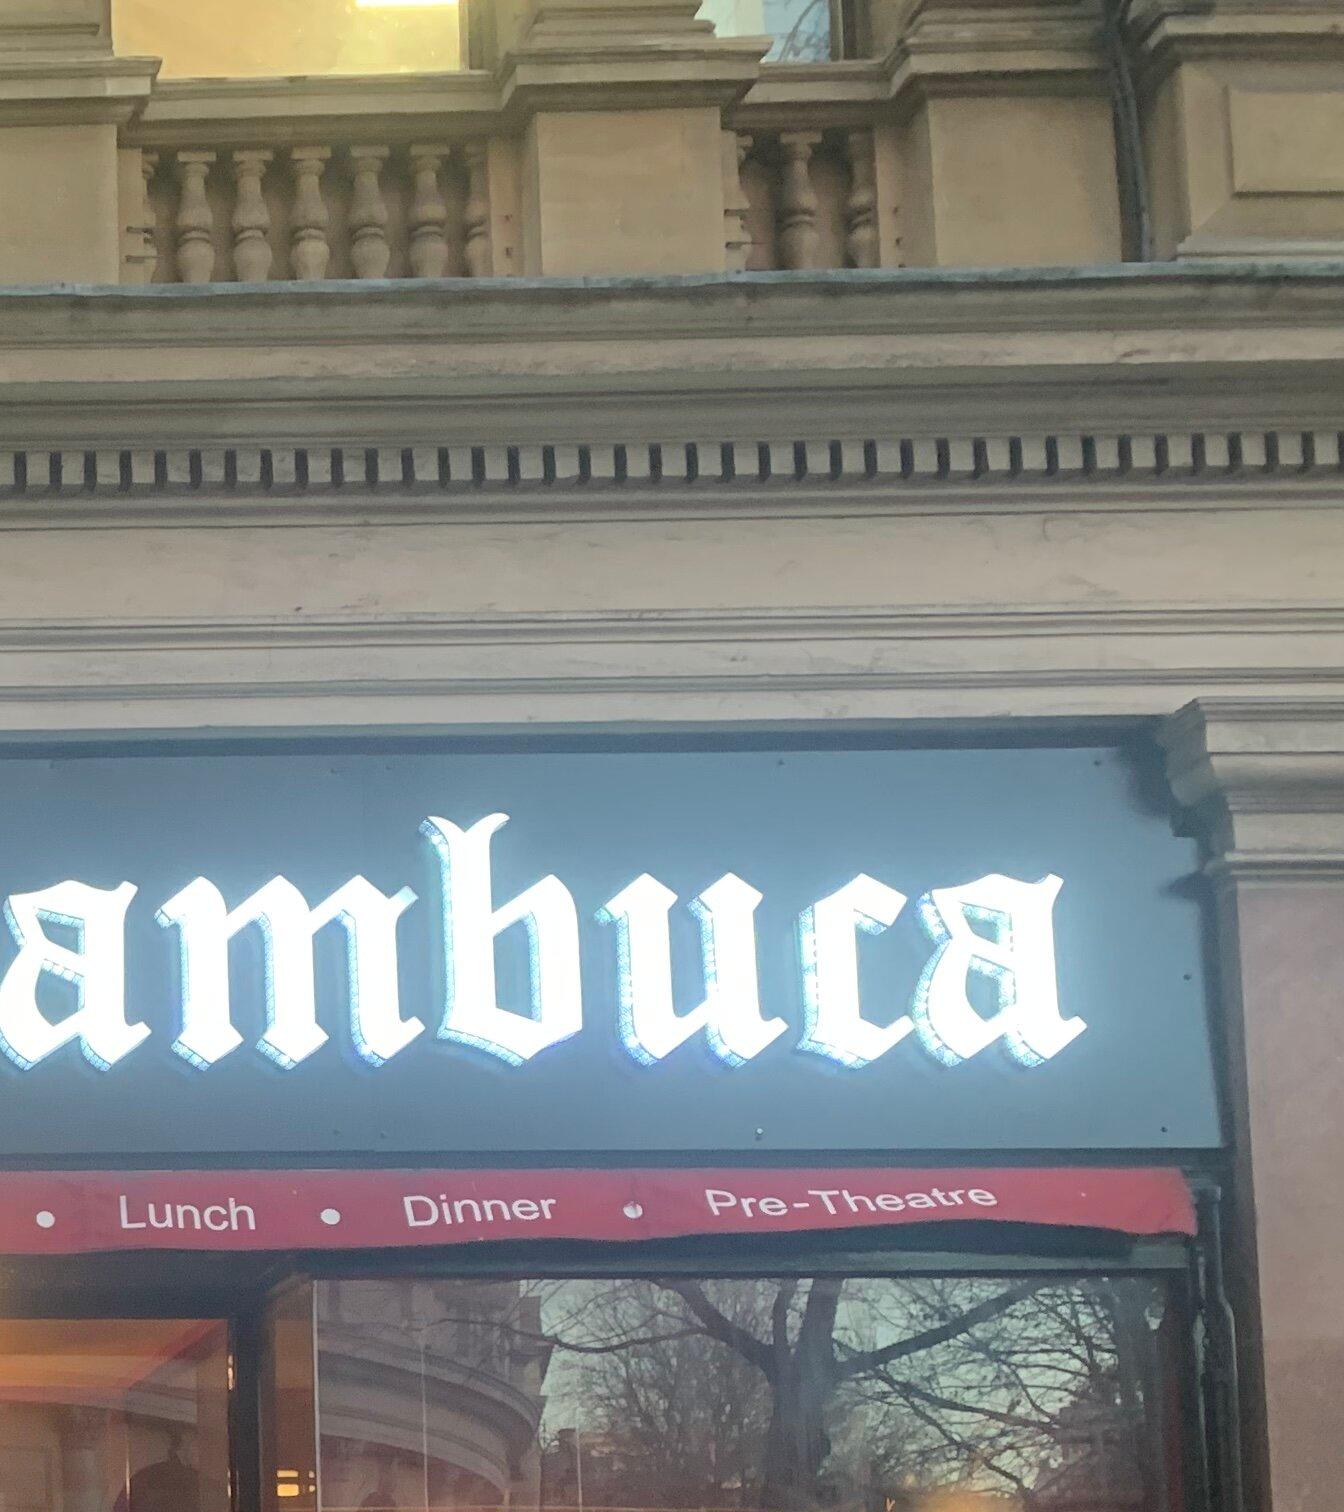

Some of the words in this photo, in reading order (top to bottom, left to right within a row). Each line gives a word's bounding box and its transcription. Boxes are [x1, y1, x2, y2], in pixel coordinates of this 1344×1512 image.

[119, 1195, 257, 1231] Lunch
[403, 1193, 557, 1227] Dinner
[705, 1185, 999, 1218] Pre-Theatre
